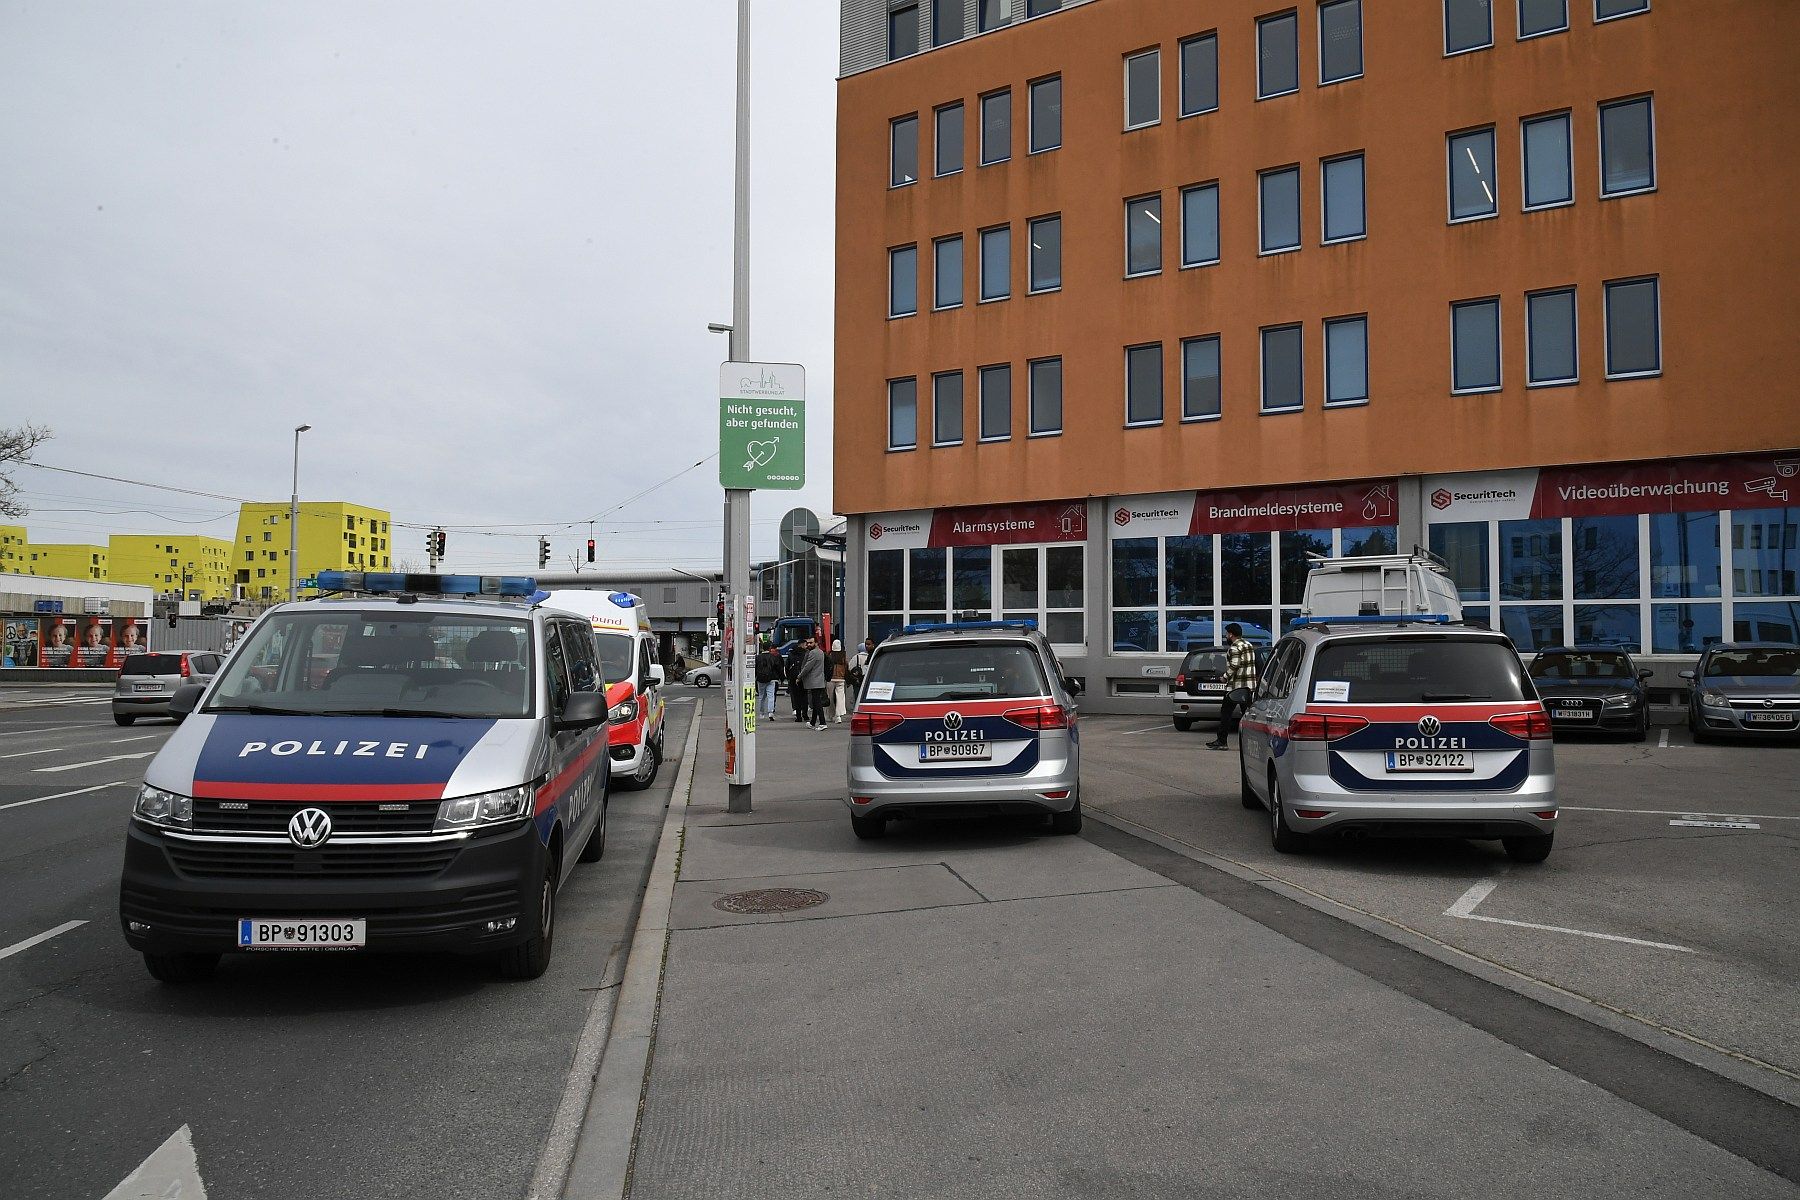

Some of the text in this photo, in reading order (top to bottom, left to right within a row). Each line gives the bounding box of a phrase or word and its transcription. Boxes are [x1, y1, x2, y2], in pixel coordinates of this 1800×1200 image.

[727, 405, 797, 418] Nicht gesucht,
[726, 418, 799, 430] aber gefunden
[1453, 489, 1516, 501] SecuritTech
[1558, 479, 1730, 500] Videoüberwachung
[1131, 508, 1179, 519] SecuritTech
[1209, 500, 1343, 519] Brandmeldesysteme
[883, 524, 920, 533] SecuritTech
[953, 518, 1035, 533] Alarmsysteme
[589, 614, 622, 626] bund
[925, 729, 984, 741] POLIZEI
[1395, 737, 1466, 749] POLIZEI
[238, 740, 429, 759] POLIZEI
[929, 745, 943, 757] BP
[951, 744, 985, 756] 90967
[1399, 754, 1414, 766] BP
[1426, 754, 1465, 766] 92122
[259, 924, 282, 942] BP
[298, 924, 354, 942] 91303
